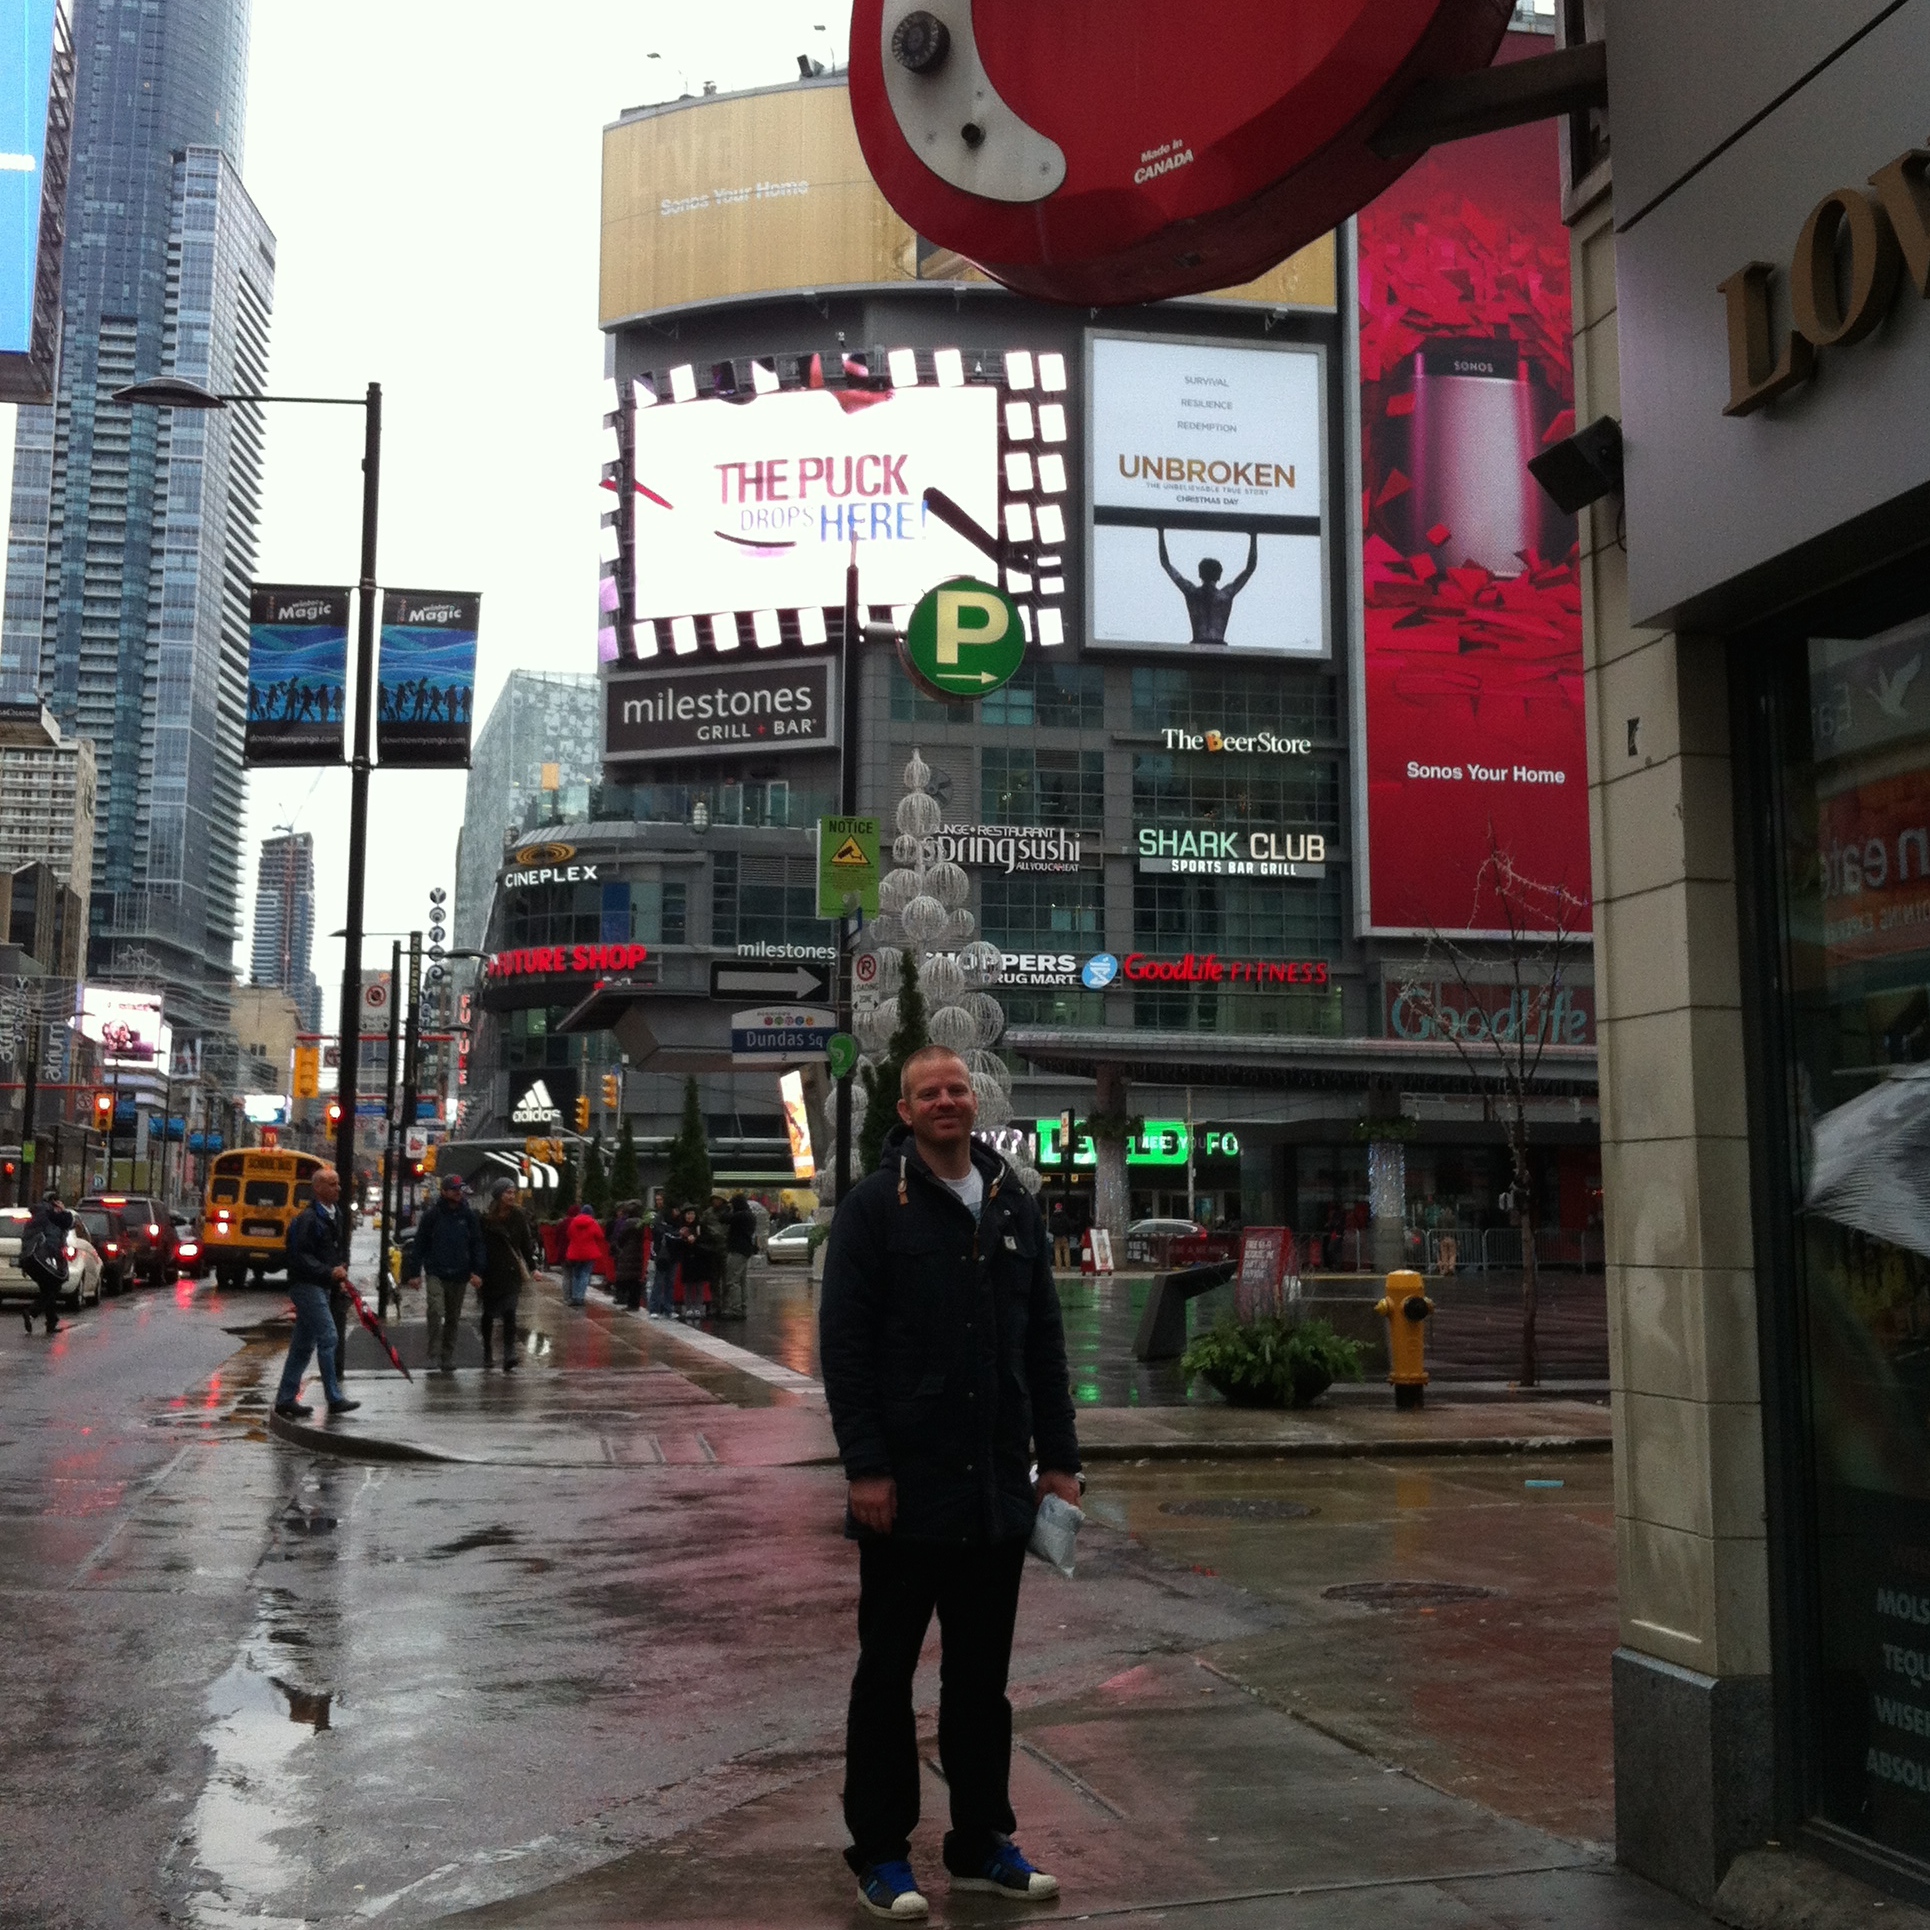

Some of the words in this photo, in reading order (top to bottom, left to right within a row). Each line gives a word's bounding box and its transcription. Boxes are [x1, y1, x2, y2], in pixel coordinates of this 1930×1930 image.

[1141, 144, 1170, 163] Made
[1134, 149, 1194, 184] CANADA
[660, 198, 710, 216] Sonos
[713, 186, 752, 205] Your
[756, 179, 809, 199] Home
[1453, 360, 1495, 373] SONOS
[1184, 375, 1230, 388] SURVIVAL
[1180, 398, 1234, 410] RESILIENCE
[1177, 420, 1237, 433] REDEMPTION
[713, 459, 789, 505] THE
[798, 454, 910, 499] PUCK
[1118, 453, 1296, 488] UNBROKEN
[1146, 481, 1160, 490] THE
[1222, 487, 1242, 496] TRUE
[1244, 488, 1270, 496] STORY
[1176, 494, 1222, 506] CHRISTMAS
[1223, 496, 1240, 506] DAY
[740, 505, 815, 531] DROPS
[278, 603, 332, 620] Magic
[408, 607, 463, 623] Magic
[936, 590, 1010, 664] P
[622, 686, 813, 725] milestones
[697, 724, 751, 741] GRILL
[773, 718, 812, 736] BAR
[1161, 728, 1204, 751] The
[1204, 729, 1258, 752] Beer
[1257, 732, 1312, 755] Store
[1406, 761, 1463, 780] Sonos
[1466, 763, 1508, 782] Your
[1513, 765, 1565, 784] Home
[828, 820, 873, 835] NOTICE
[977, 825, 1056, 838] RESTAURANT
[1018, 827, 1081, 862] sushi
[1138, 828, 1239, 859] SHARK
[1250, 832, 1326, 862] CLUB
[1015, 860, 1031, 871] ALL
[1030, 861, 1048, 872] YOU
[1064, 862, 1080, 873] EAT
[1171, 859, 1222, 873] SPORTS
[1228, 861, 1254, 874] BAR
[1260, 862, 1297, 876] GRILL
[505, 865, 598, 888] CINEPLEX
[572, 944, 647, 972] SHOP
[737, 940, 836, 959] milestones
[1123, 953, 1224, 982] GoodLife
[1230, 962, 1329, 984] FITNESS
[853, 982, 879, 992] LOADING
[1030, 974, 1075, 985] MART
[745, 1030, 804, 1048] Dundas
[808, 1033, 824, 1049] Sq
[43, 1020, 65, 1082] atrium
[781, 1053, 788, 1061] 2
